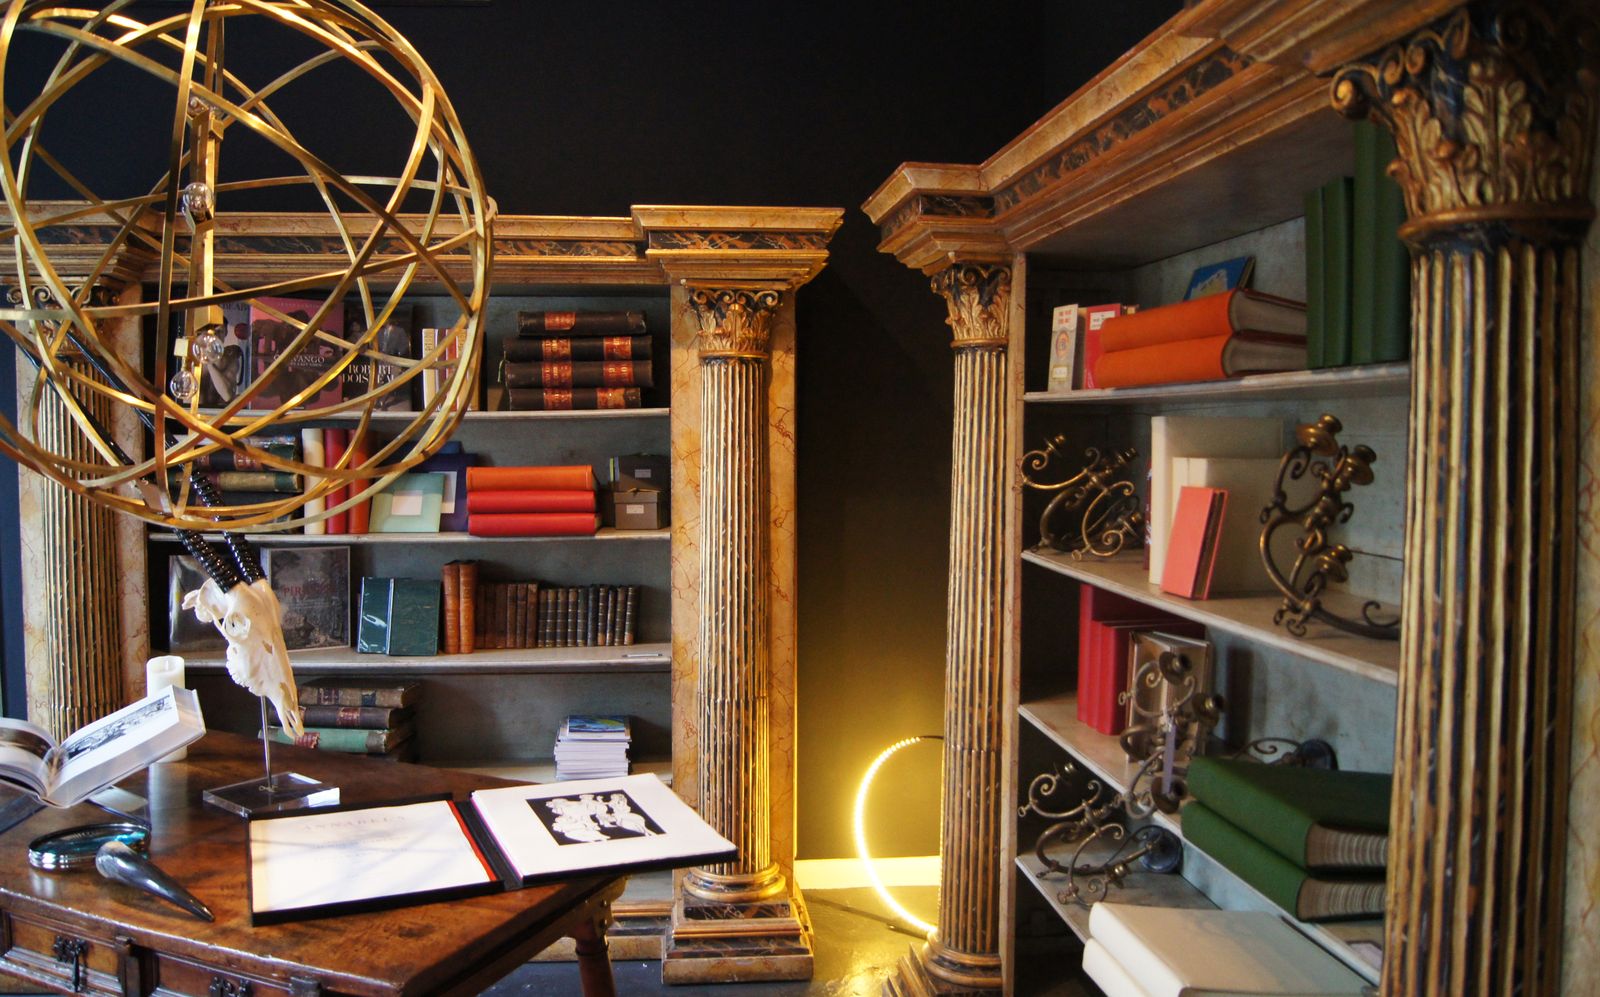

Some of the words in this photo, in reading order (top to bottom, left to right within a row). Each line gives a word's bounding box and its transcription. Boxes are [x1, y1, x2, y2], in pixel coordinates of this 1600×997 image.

[273, 353, 325, 363] OVANGO
[348, 364, 393, 375] ROBRT
[342, 373, 396, 384] DOISEA
